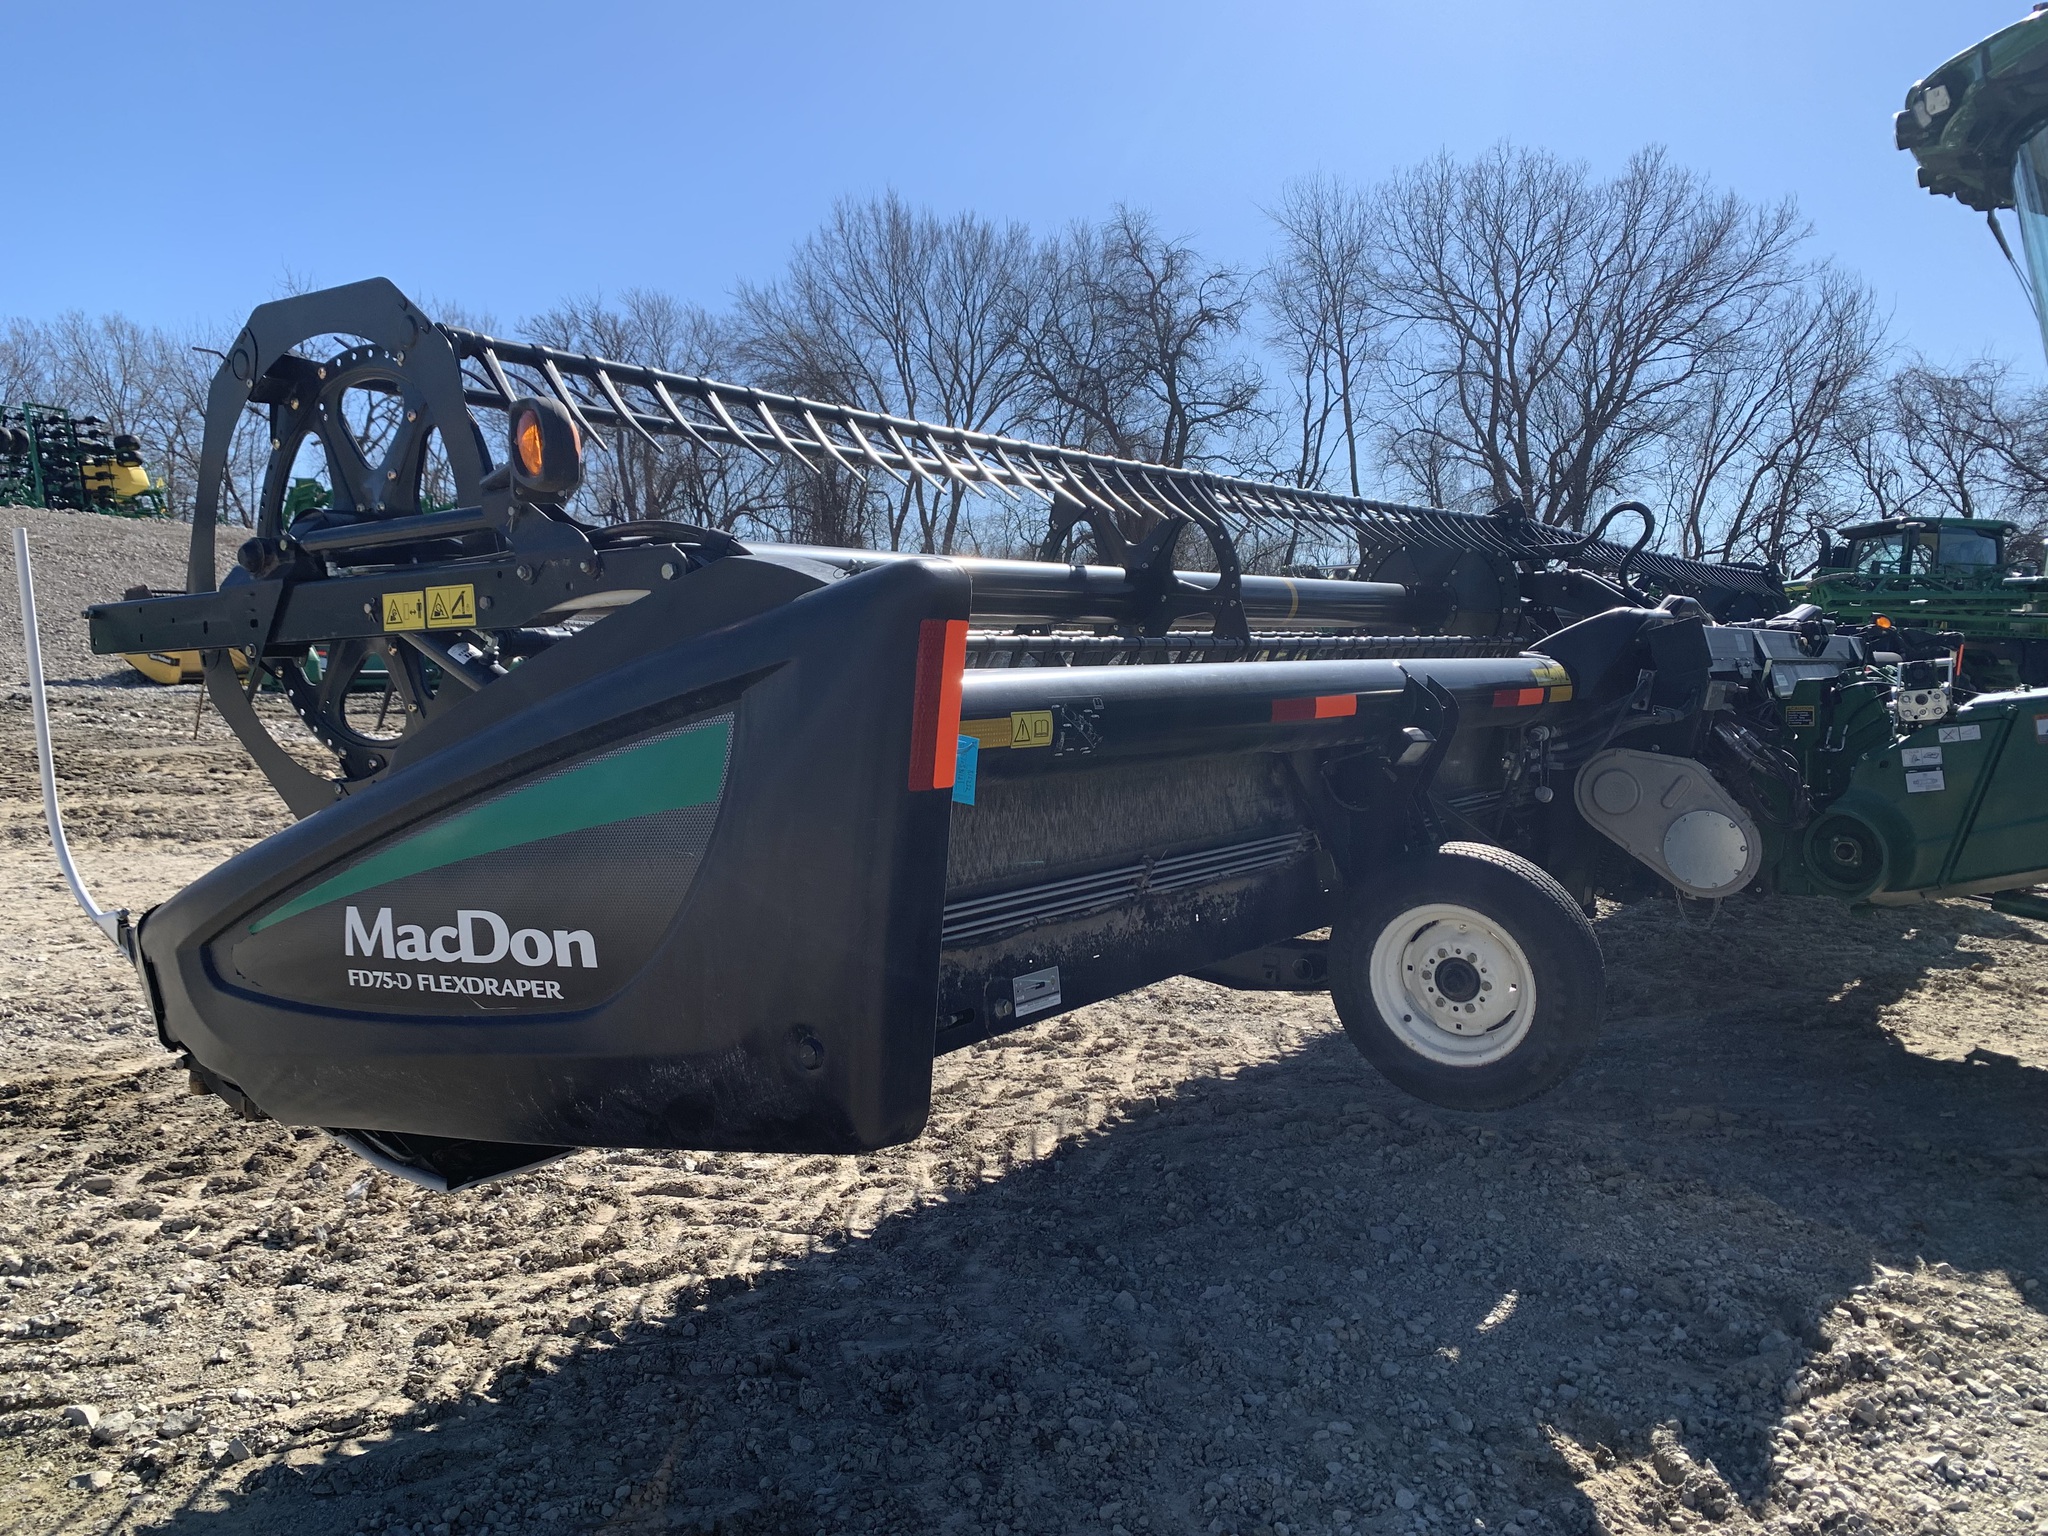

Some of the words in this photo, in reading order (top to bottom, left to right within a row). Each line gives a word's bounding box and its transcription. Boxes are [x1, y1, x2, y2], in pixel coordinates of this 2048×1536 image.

[345, 905, 598, 968] MacDon
[347, 969, 412, 990] FD75-D
[416, 973, 564, 1000] FLEXDRAPER
